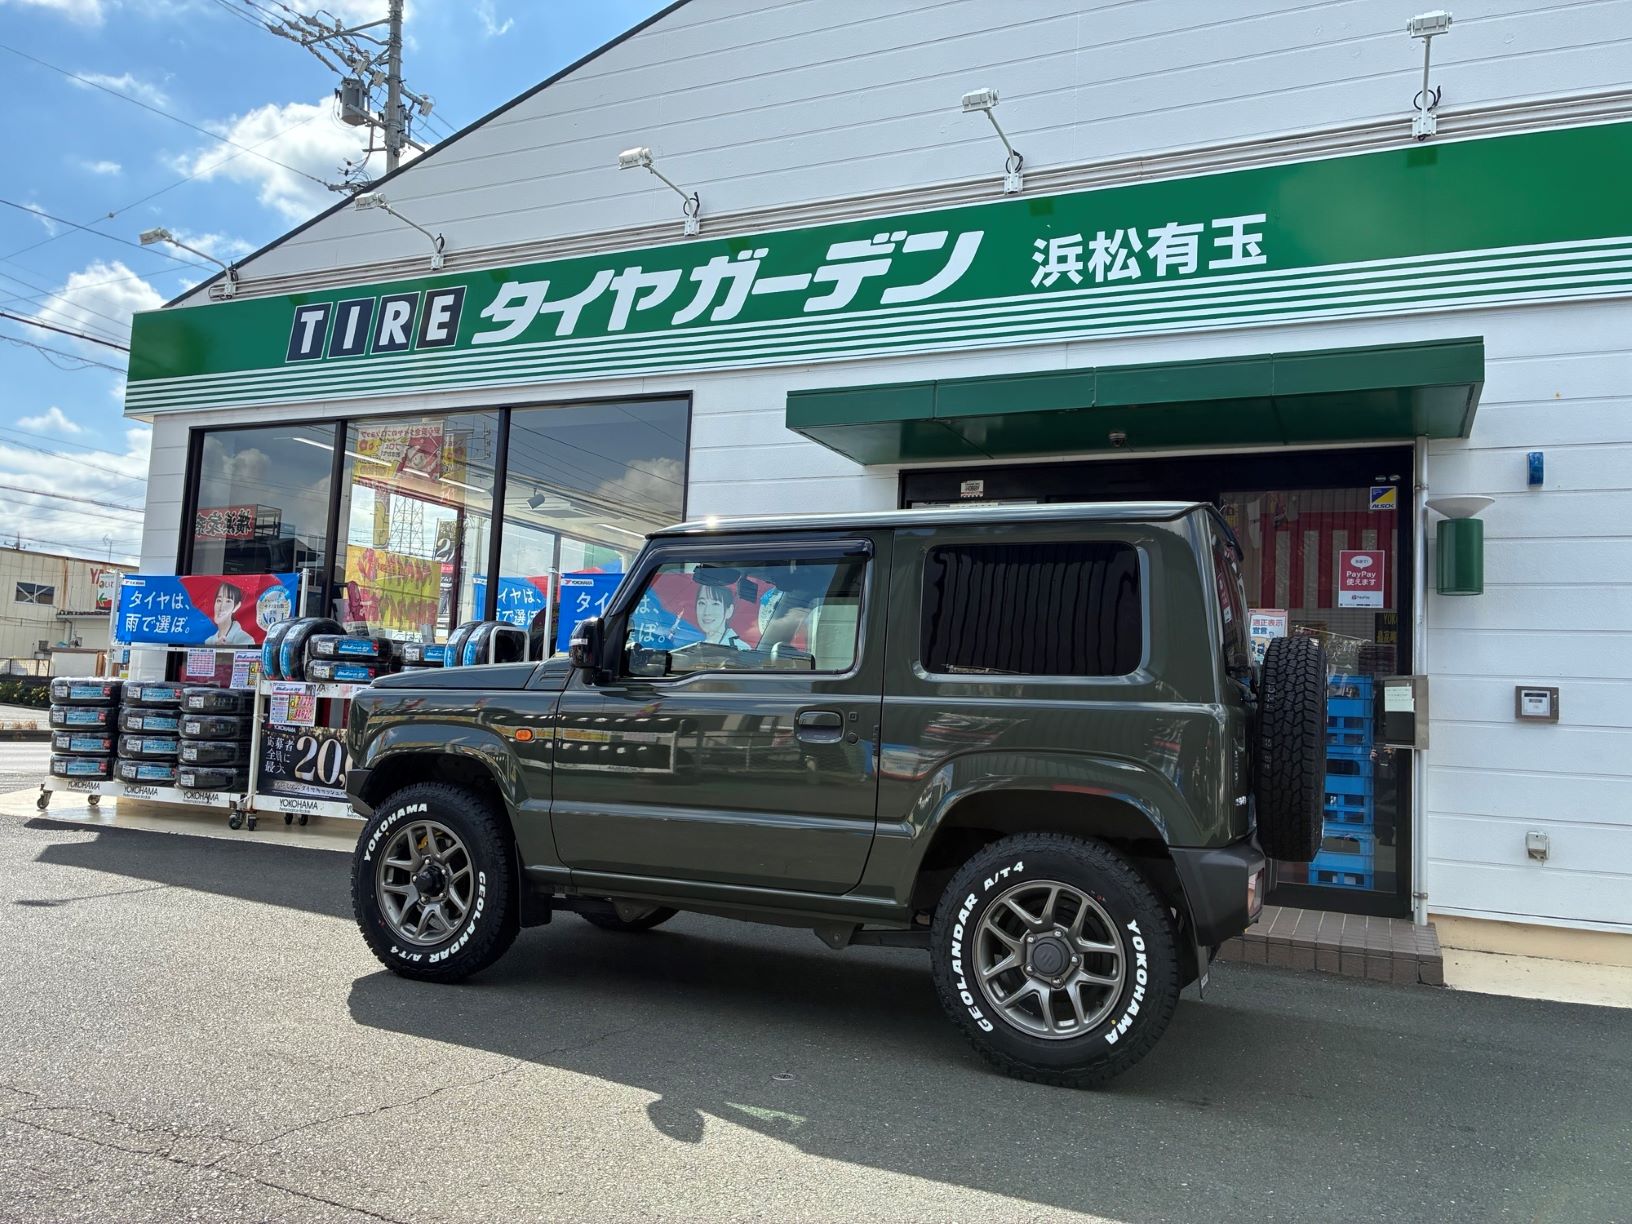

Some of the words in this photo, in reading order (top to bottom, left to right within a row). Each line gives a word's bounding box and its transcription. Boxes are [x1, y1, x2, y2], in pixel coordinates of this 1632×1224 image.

[1030, 213, 1267, 288] 浜松有玉
[300, 294, 455, 354] TIRE
[471, 230, 985, 345] タイヤガーデン
[1346, 571, 1376, 579] PayPay
[1346, 578, 1376, 586] 使えます
[128, 590, 190, 610] タイヤは、
[498, 588, 541, 604] イヤは、
[265, 748, 291, 763] 全員に
[265, 761, 286, 774] 最大
[67, 781, 100, 790] YOKOHAMA
[124, 786, 158, 796] YOKOHAMA
[183, 790, 219, 802] YOKOHAMA
[279, 798, 318, 810] YOKOHAMA
[364, 803, 428, 862] YOKOHAMA
[428, 871, 486, 963] GEOLANDAR
[951, 893, 994, 1032] GEOLANDAR
[1104, 919, 1148, 1045] YOKOHAMA
